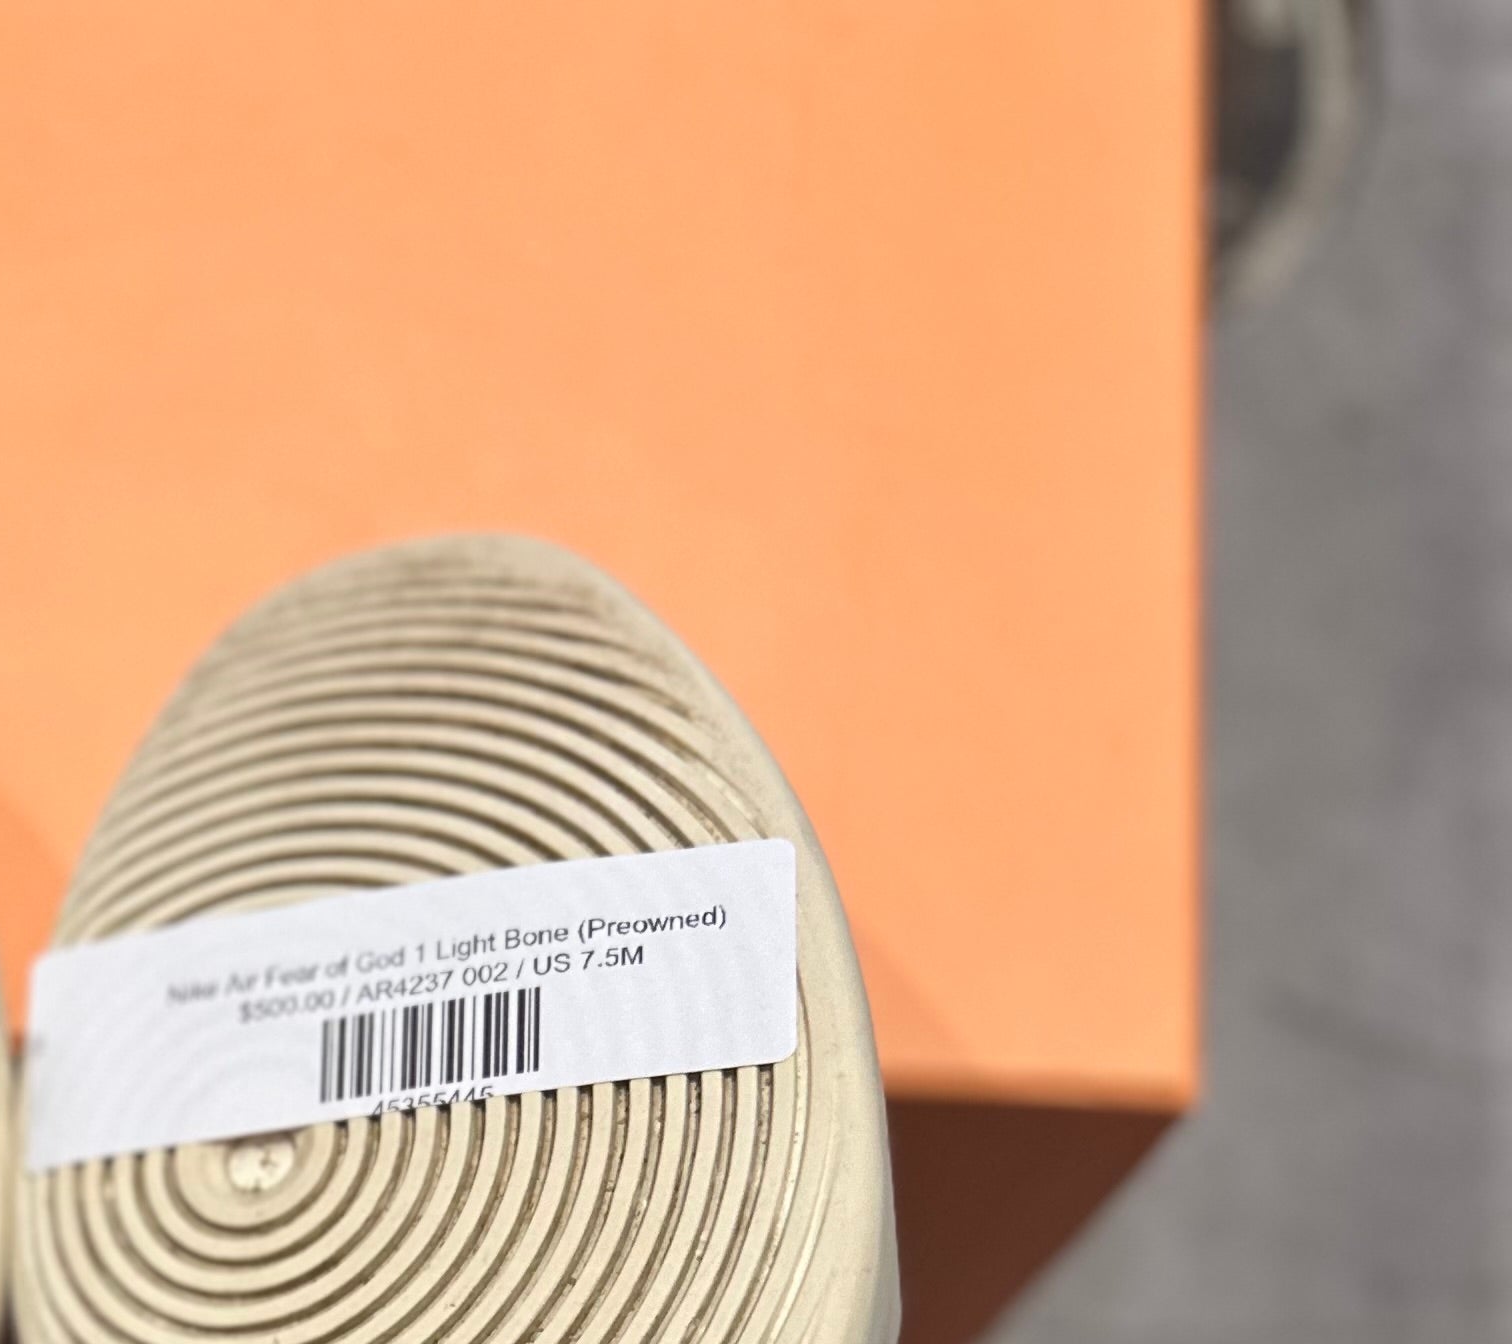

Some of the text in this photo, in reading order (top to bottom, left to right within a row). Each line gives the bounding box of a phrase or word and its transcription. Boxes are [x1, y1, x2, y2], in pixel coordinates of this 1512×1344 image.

[264, 963, 319, 988] Fear
[325, 954, 348, 978] of
[355, 946, 405, 974] God
[415, 943, 426, 963] 1
[437, 933, 497, 961] Light
[504, 927, 569, 951] Bone
[578, 904, 727, 944] (Preowned)
[341, 984, 352, 1007] /
[355, 970, 454, 1005] AR4237
[462, 961, 508, 987] 002
[515, 958, 526, 980] /
[533, 953, 572, 976] US
[580, 944, 644, 971] 7.5M
